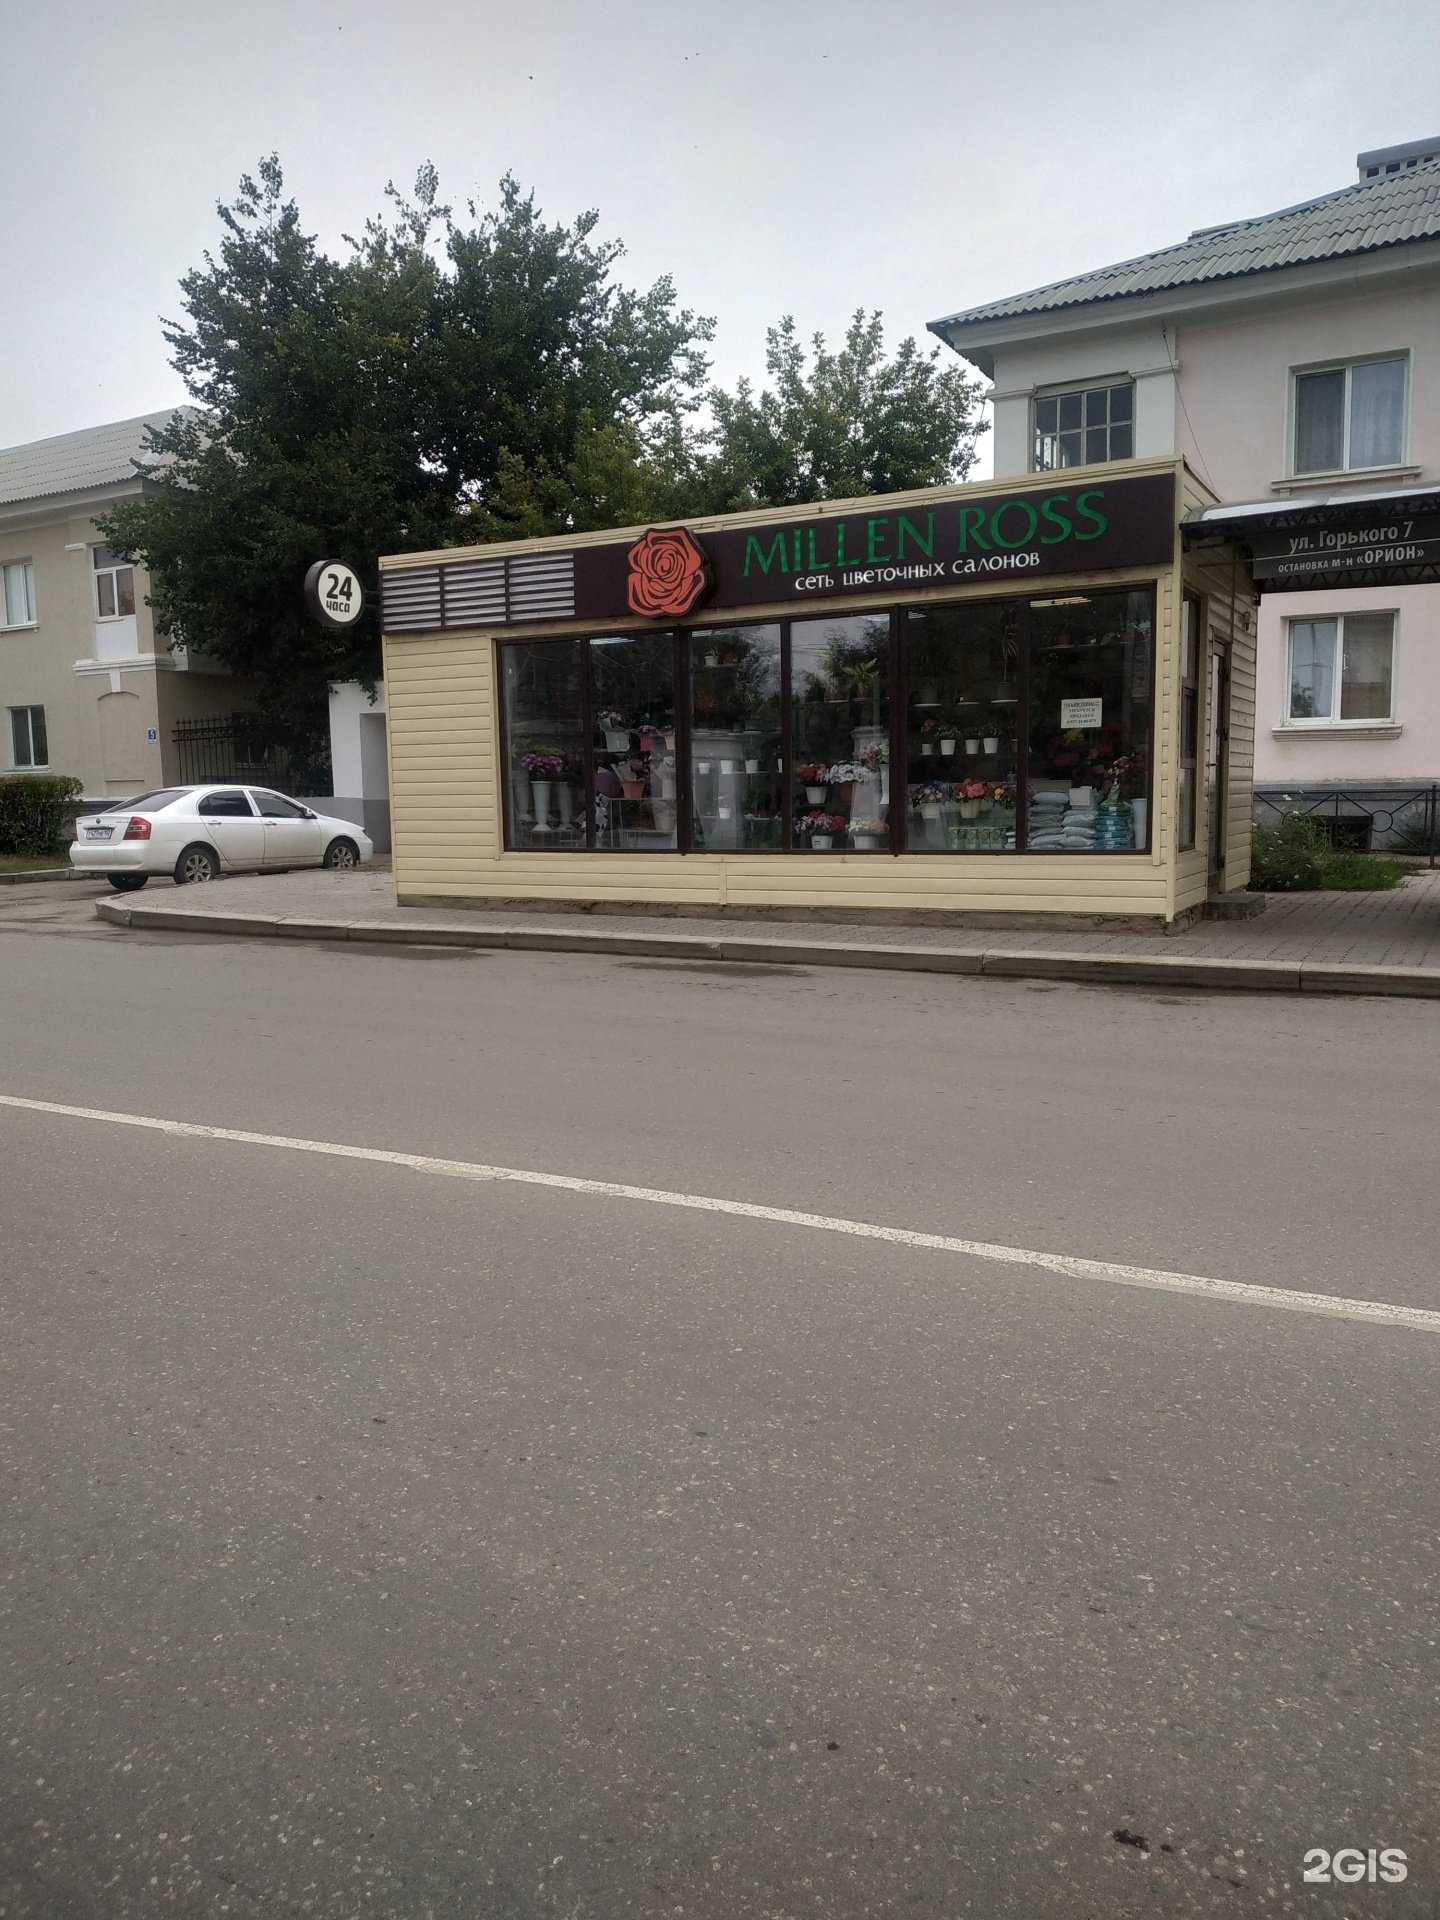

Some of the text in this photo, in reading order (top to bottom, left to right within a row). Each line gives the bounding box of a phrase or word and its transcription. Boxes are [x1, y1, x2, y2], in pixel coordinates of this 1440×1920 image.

[743, 489, 1110, 577] MILLEN ROSS
[1289, 521, 1414, 554] ул. Горького 7
[326, 573, 353, 602] 24
[794, 550, 1041, 592] сеть цветочных салонов
